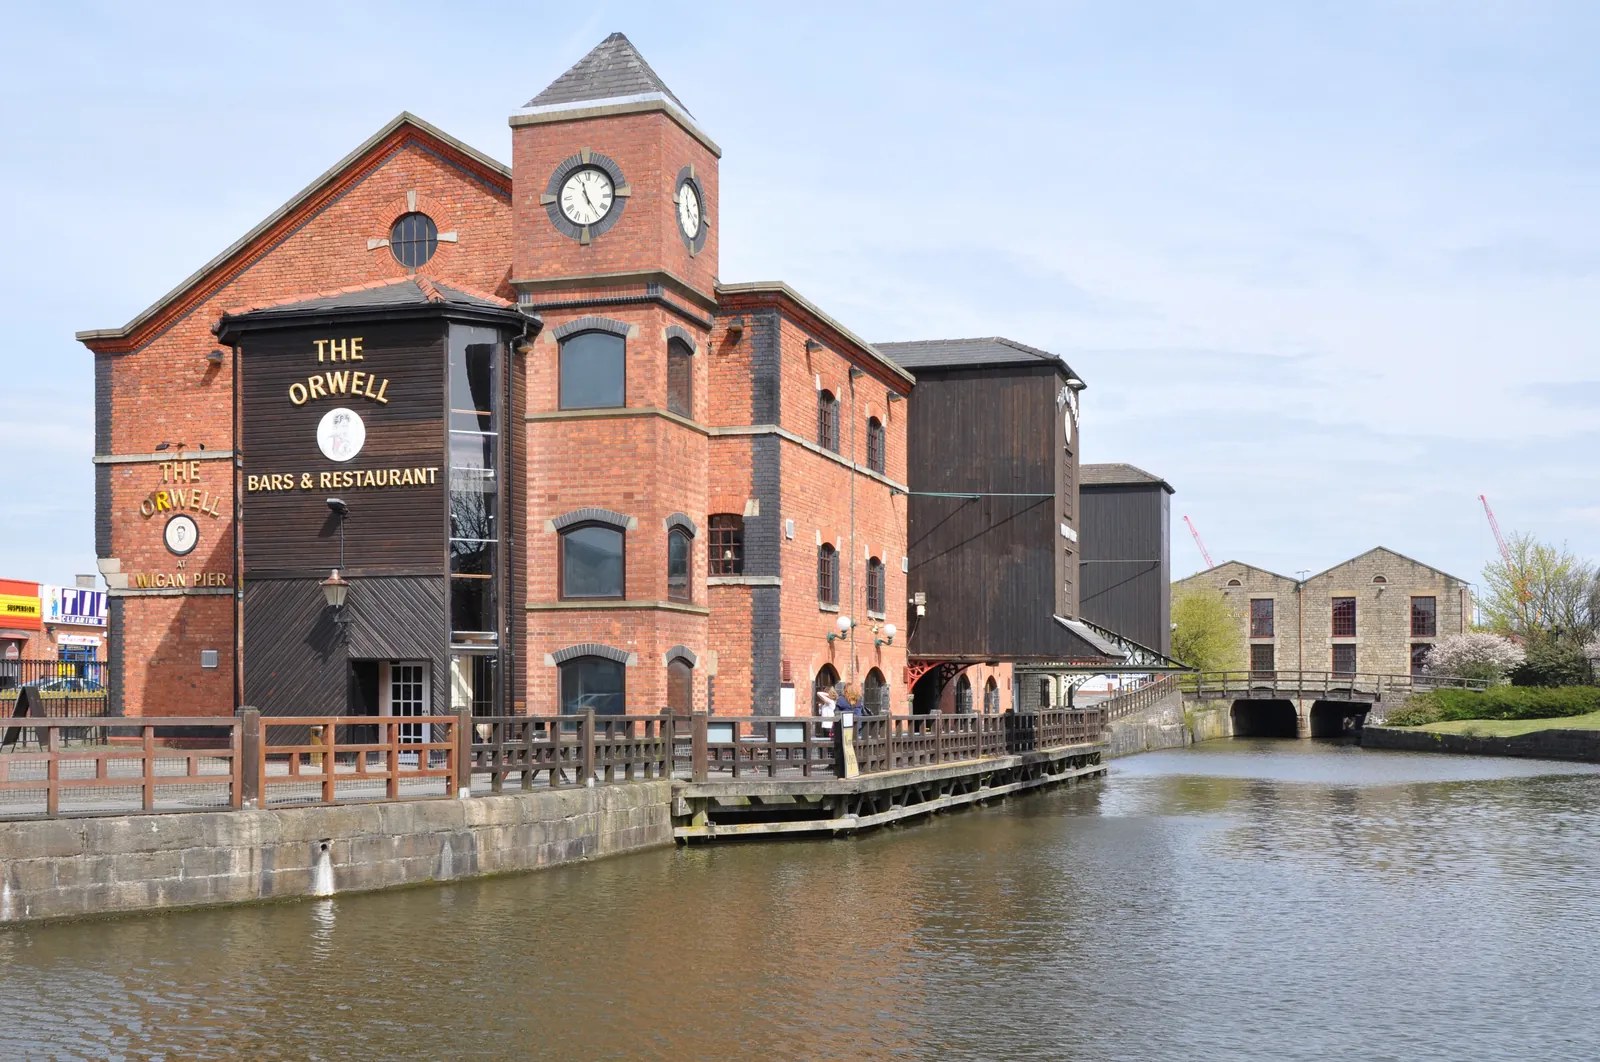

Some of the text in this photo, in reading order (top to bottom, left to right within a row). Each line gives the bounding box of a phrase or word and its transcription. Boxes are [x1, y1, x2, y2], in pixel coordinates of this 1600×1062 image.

[313, 337, 364, 362] THE
[289, 371, 390, 405] ORWELL
[159, 461, 201, 482] THE
[248, 467, 439, 491] BARS & RESTAURANT
[141, 488, 220, 517] ORWELL
[176, 560, 187, 569] AT
[136, 572, 227, 588] WIGAN PIER
[7, 604, 35, 613] SUSPENSION
